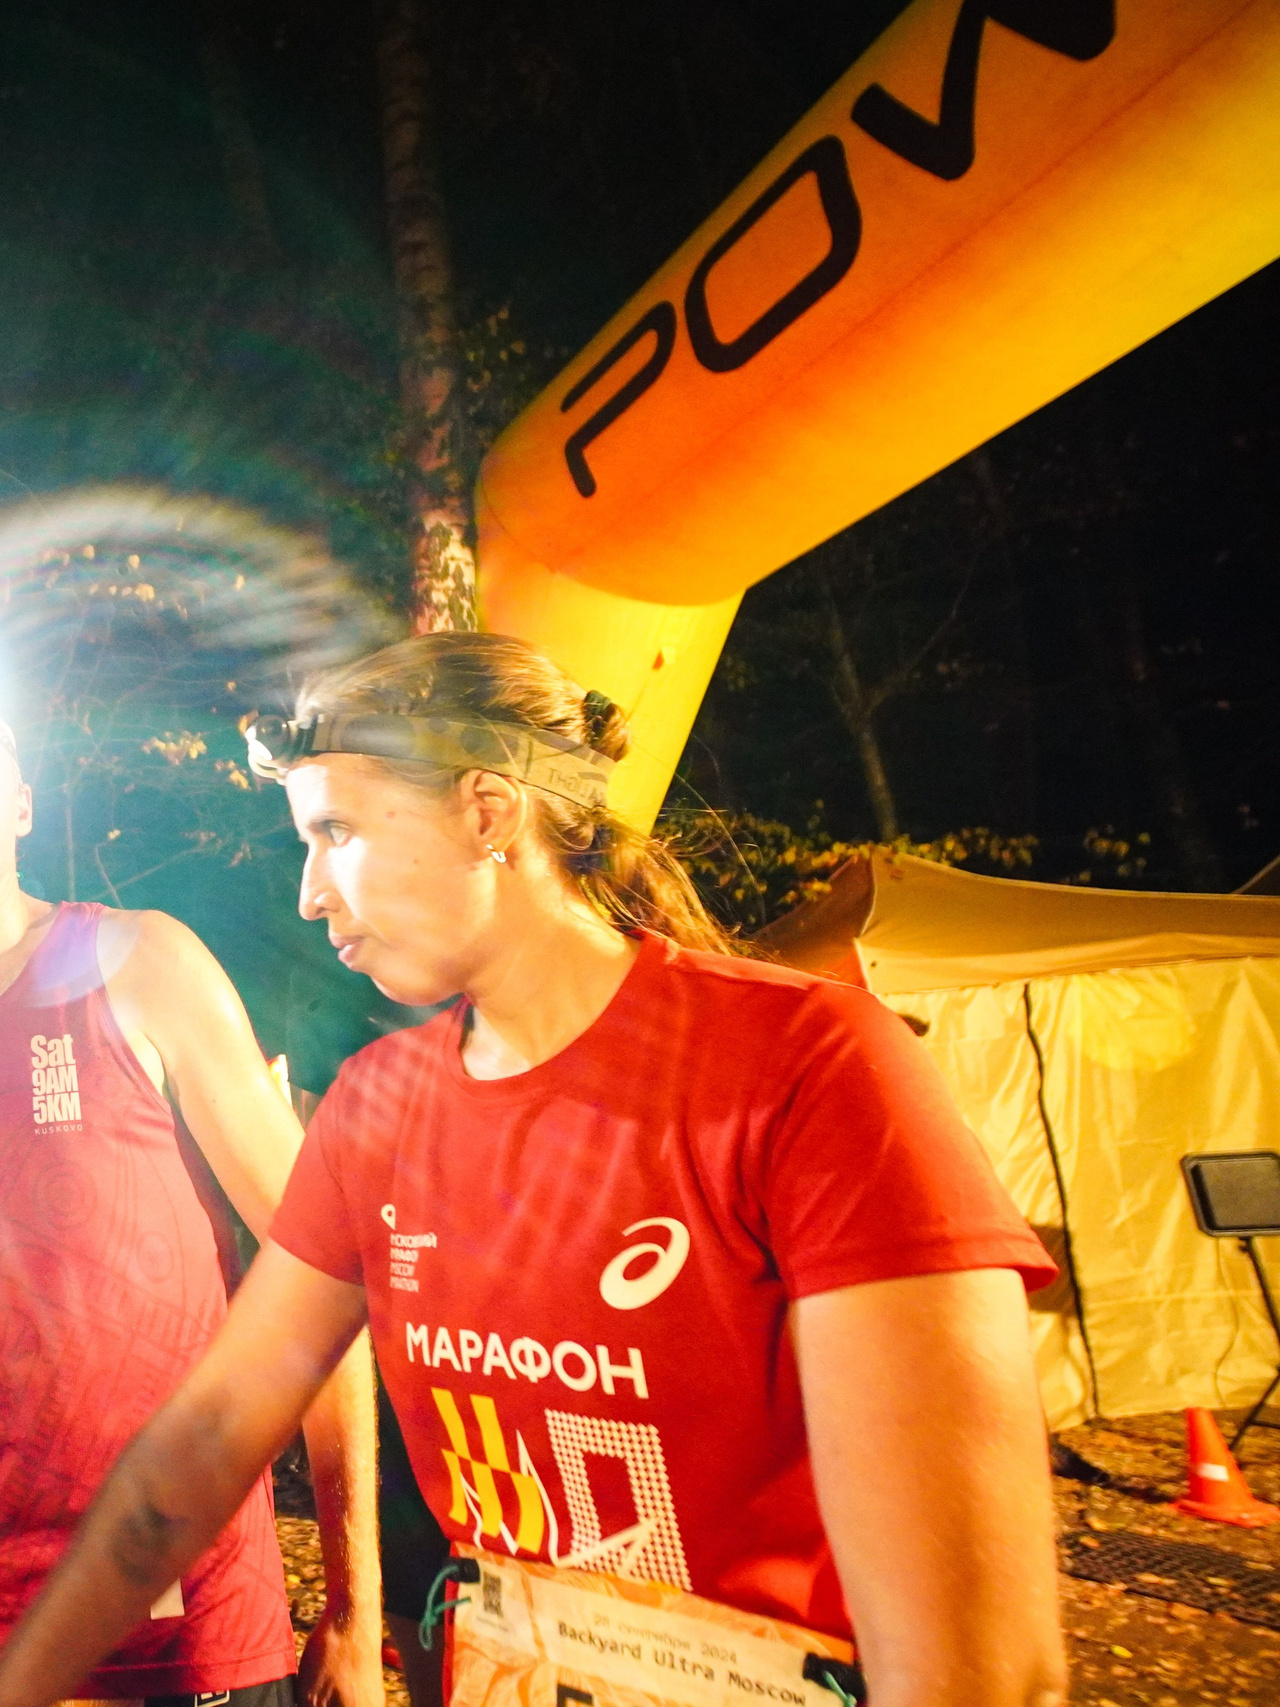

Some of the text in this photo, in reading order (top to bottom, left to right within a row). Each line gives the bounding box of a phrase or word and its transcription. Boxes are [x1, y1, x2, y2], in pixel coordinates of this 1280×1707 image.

[559, 0, 1117, 498] POW
[30, 1033, 76, 1069] Sat
[31, 1065, 79, 1096] 9AM
[32, 1092, 82, 1125] 5KM
[35, 1123, 83, 1135] KUSKOVO
[406, 1321, 649, 1399] МАРАФОН
[558, 1620, 806, 1707] Backyard Ultra Moscow
